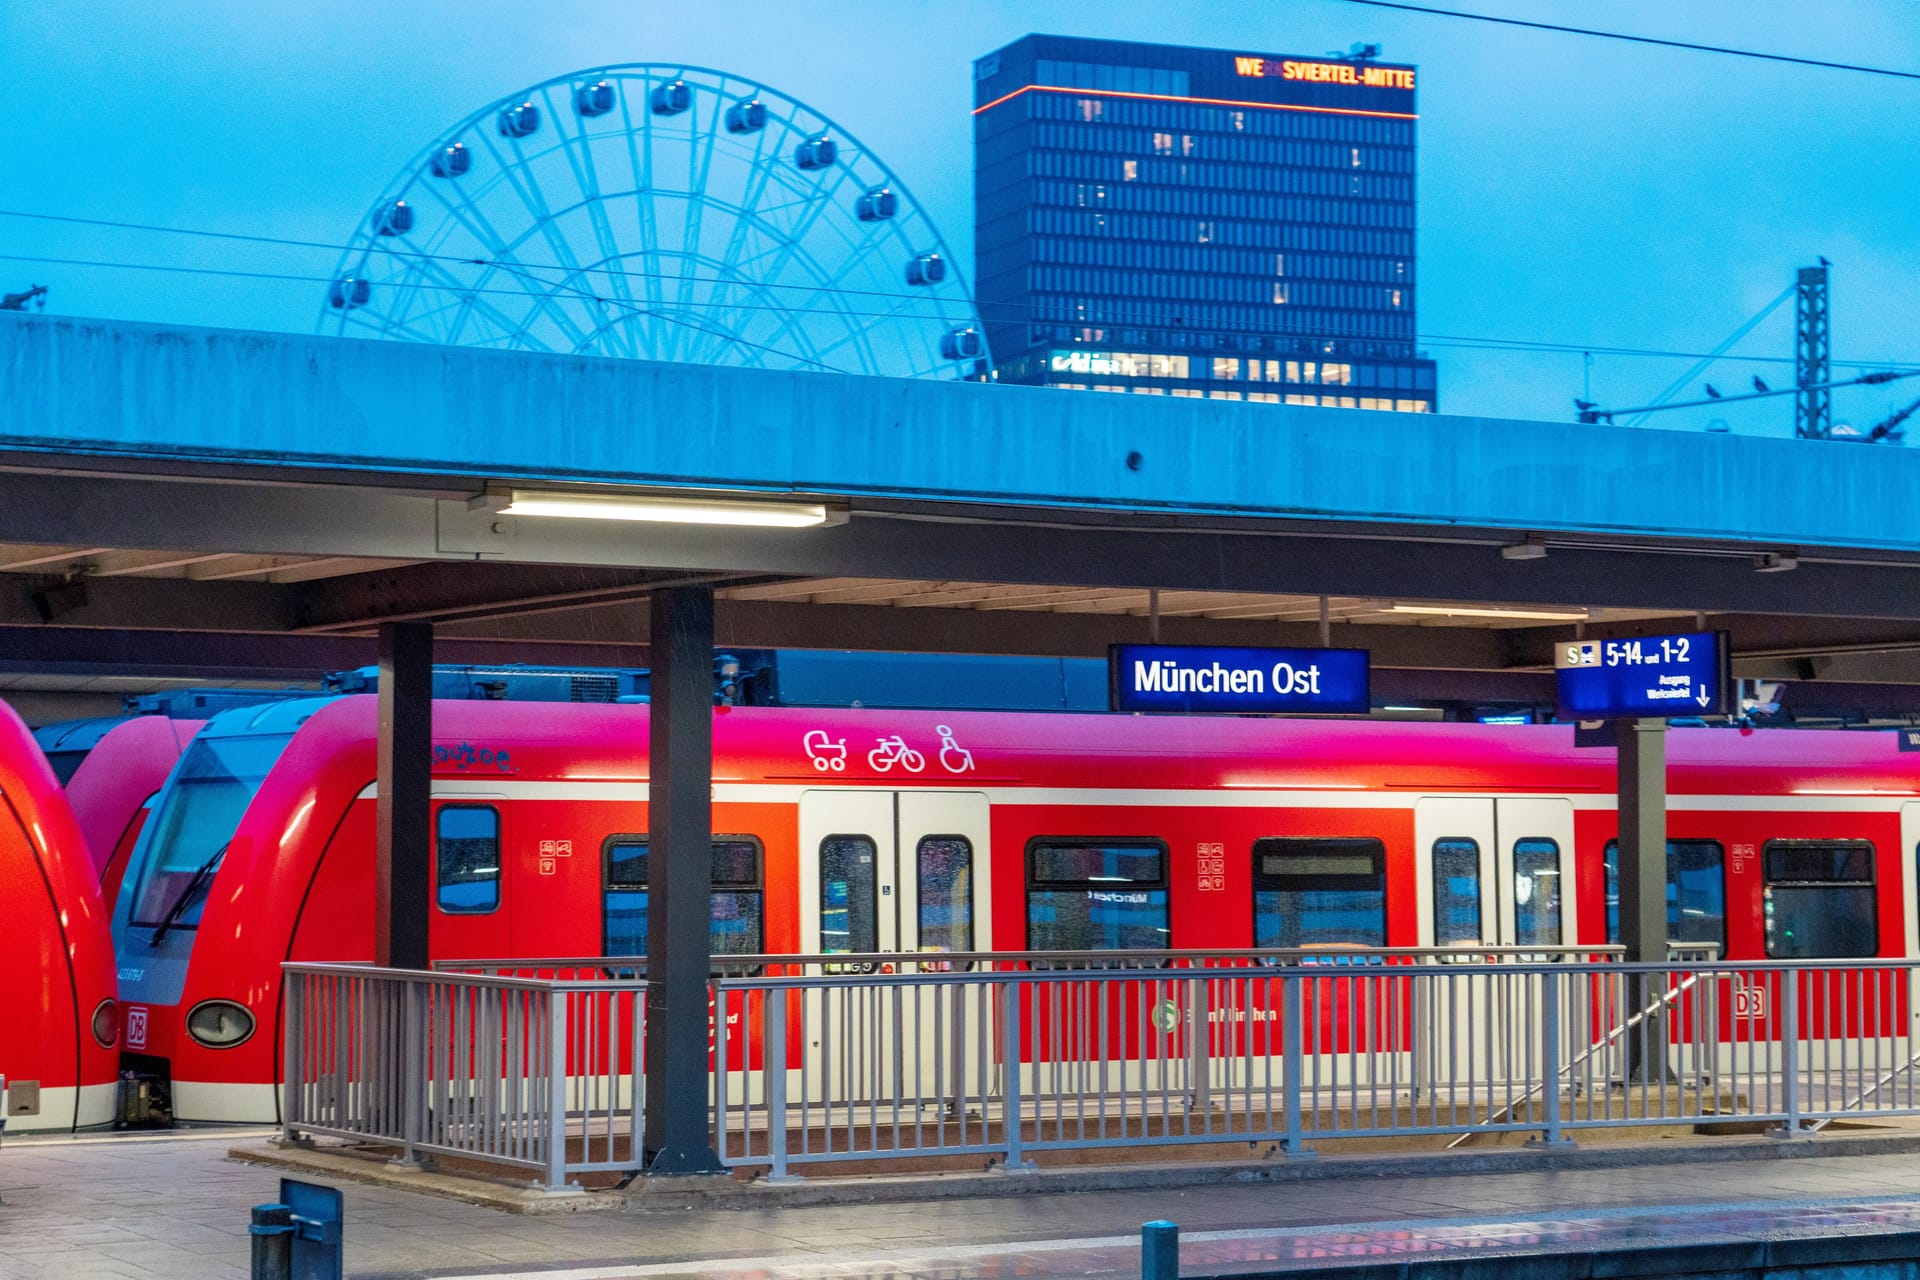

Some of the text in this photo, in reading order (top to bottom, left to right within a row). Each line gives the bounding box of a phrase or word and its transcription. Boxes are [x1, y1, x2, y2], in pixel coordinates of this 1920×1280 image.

[1567, 646, 1579, 665] S
[1606, 641, 1643, 667] 5-14
[1660, 637, 1690, 663] 1-2
[1134, 660, 1321, 694] München Ost
[129, 1013, 145, 1041] DB
